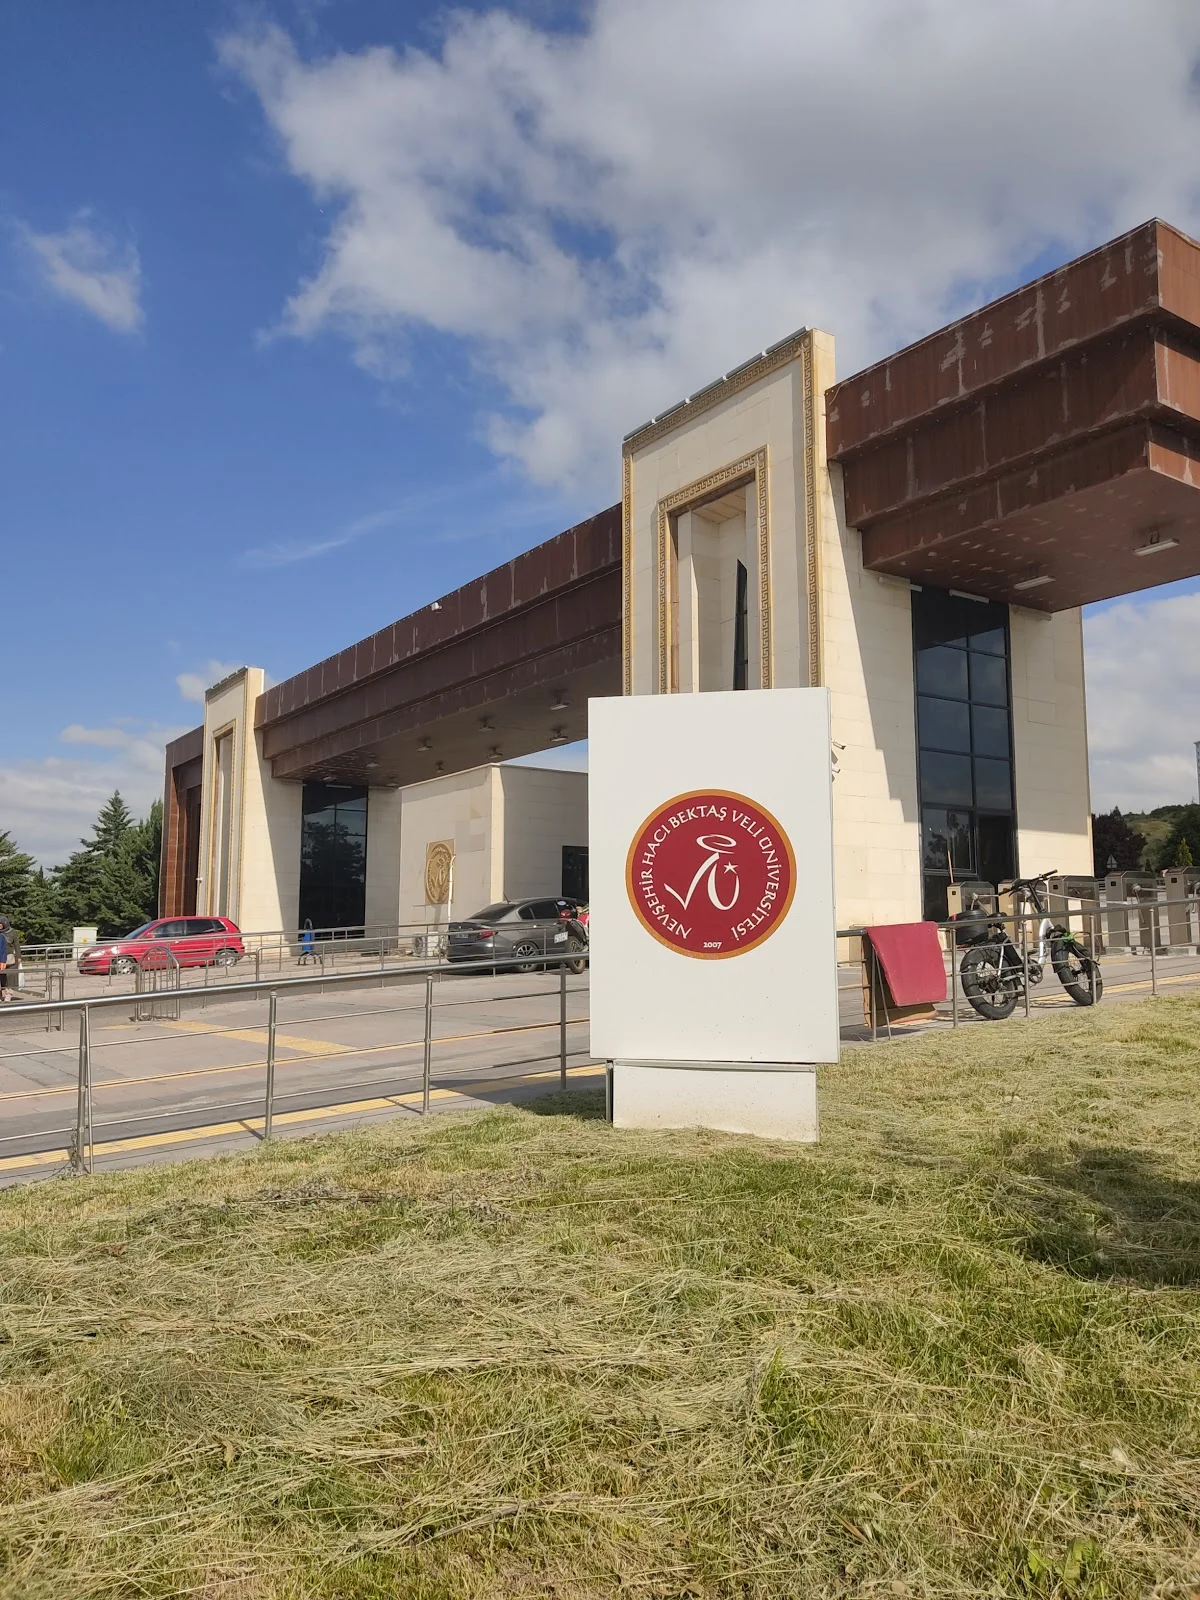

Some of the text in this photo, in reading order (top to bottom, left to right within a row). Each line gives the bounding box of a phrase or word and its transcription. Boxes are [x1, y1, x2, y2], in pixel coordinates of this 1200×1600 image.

[639, 805, 782, 941] NEVŞEHİR HACI BEKTAŞ VELİ ÜNİVERSİTESİ
[703, 941, 722, 949] 2007
